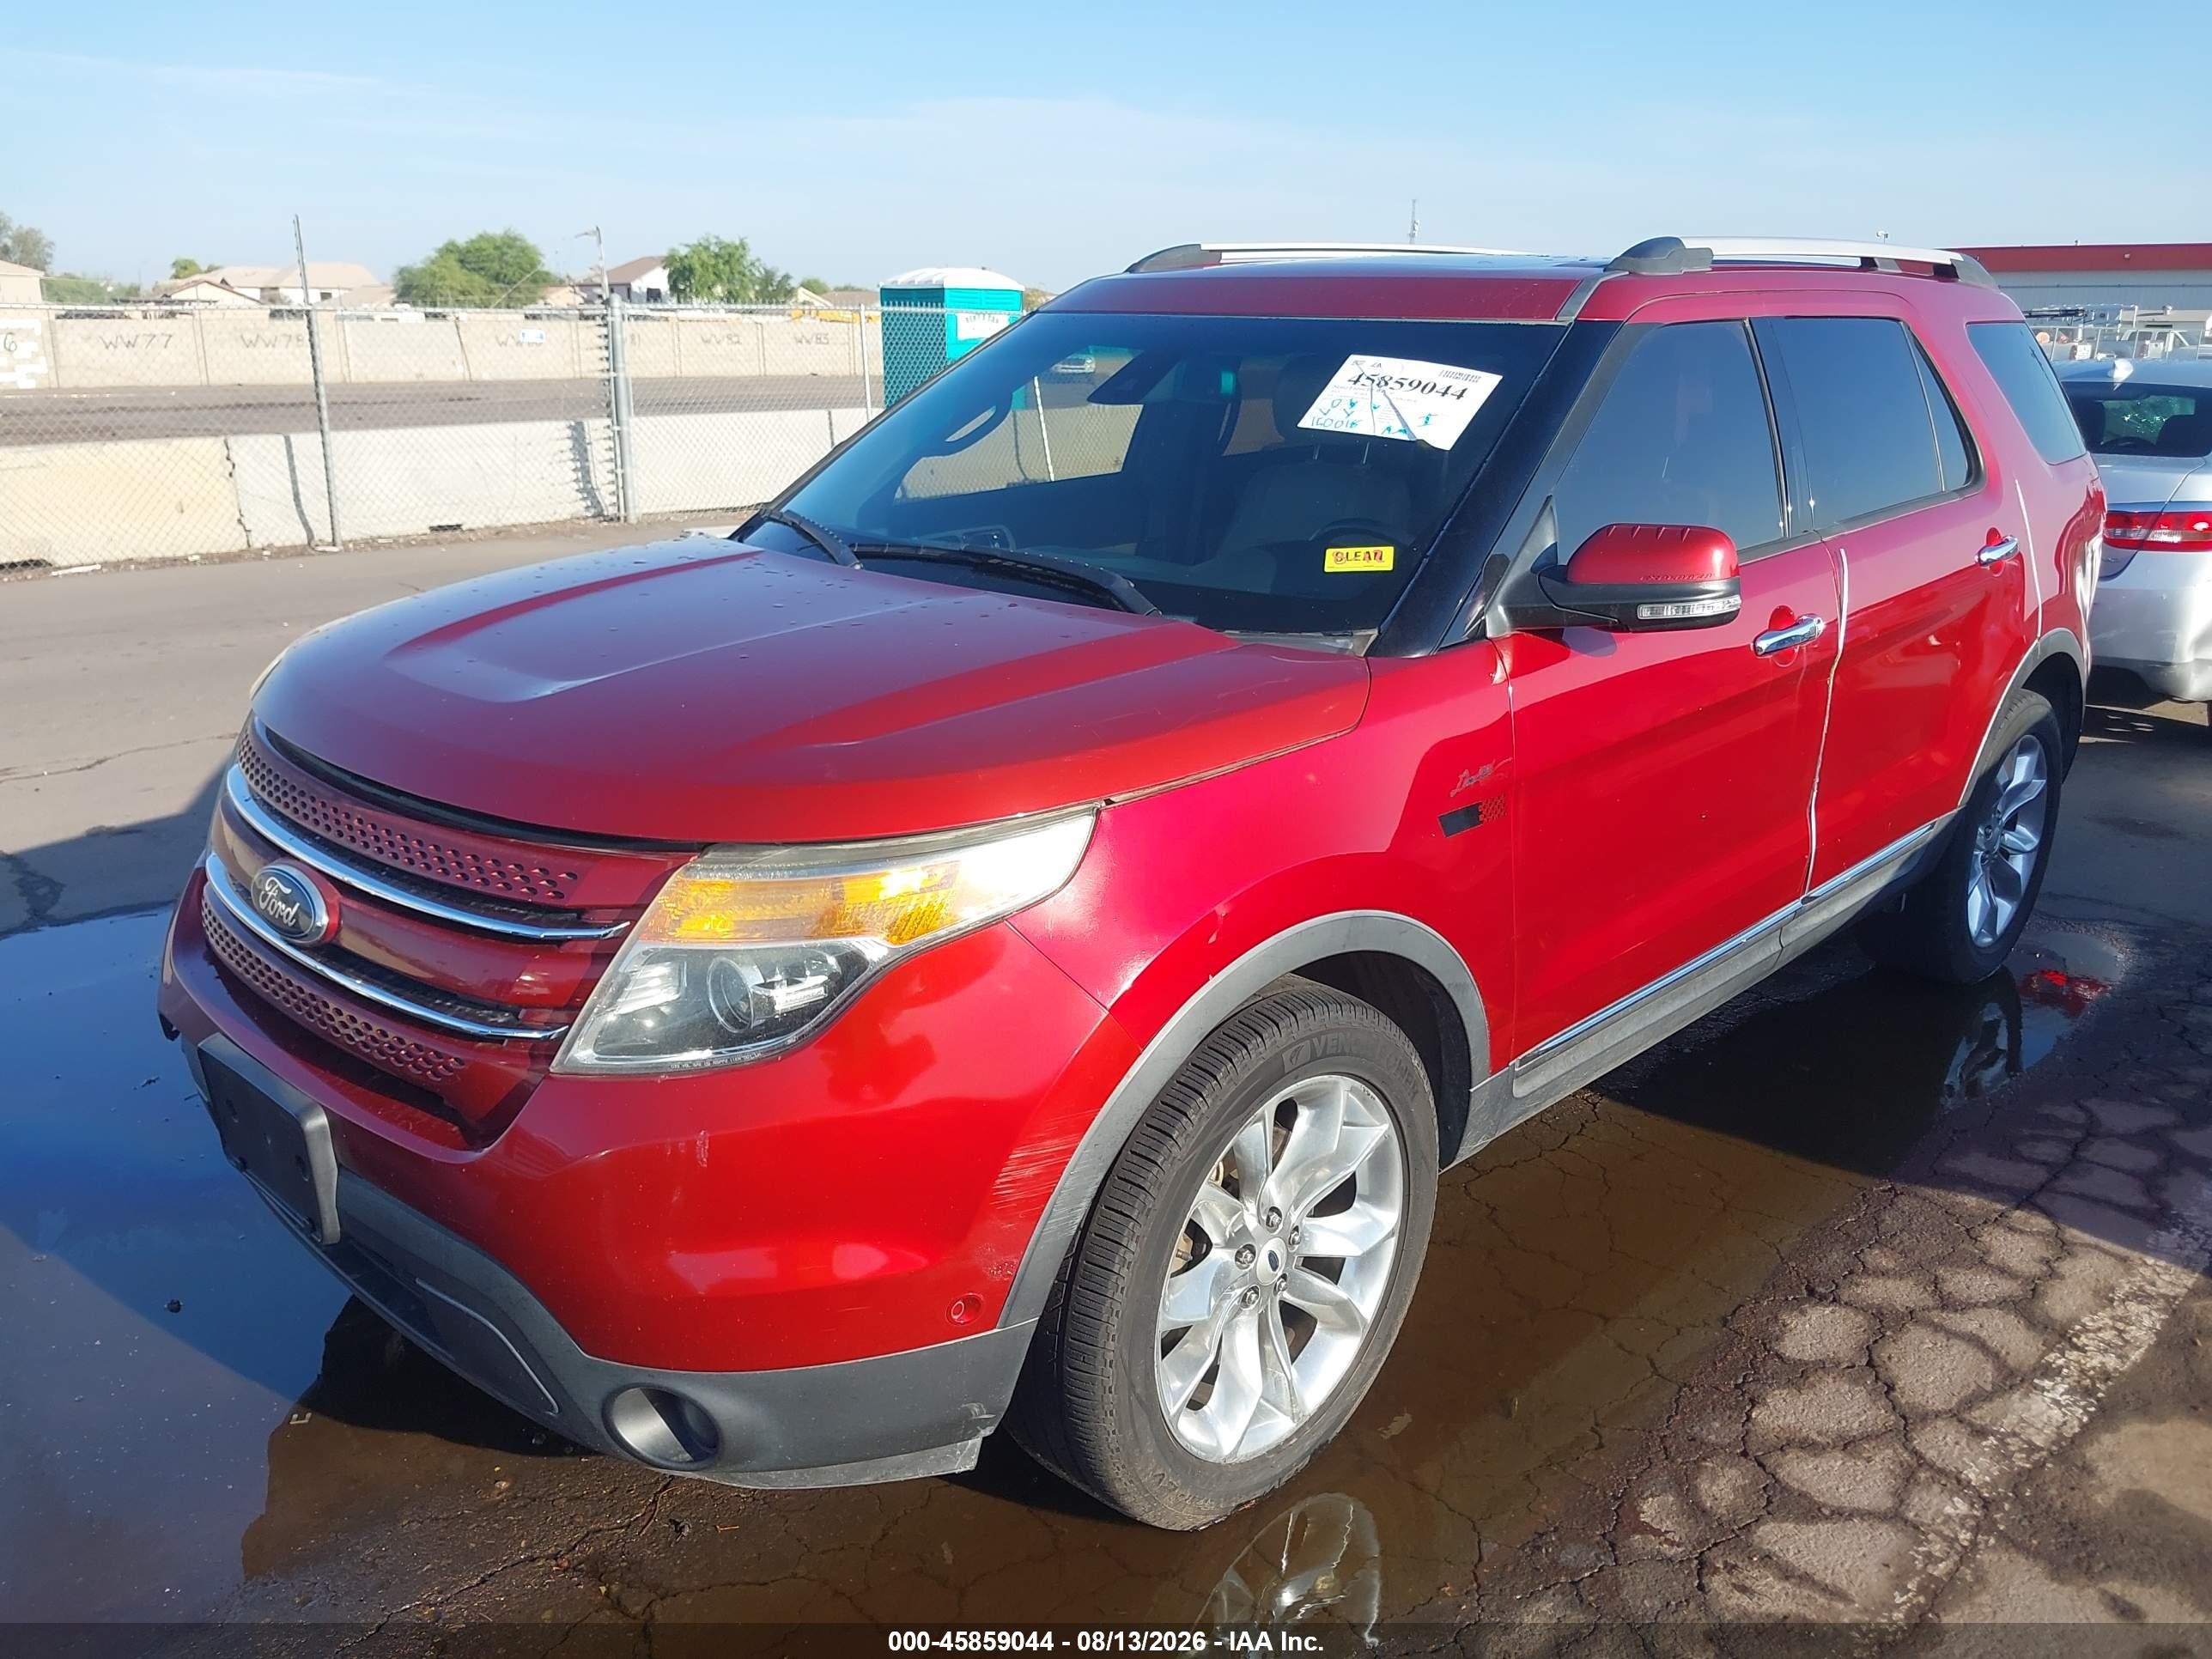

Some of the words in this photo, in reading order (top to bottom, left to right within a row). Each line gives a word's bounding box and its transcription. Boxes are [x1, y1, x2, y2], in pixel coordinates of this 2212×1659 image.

[100, 334, 173, 349] WW77
[1347, 372, 1468, 401] 45859044
[259, 877, 301, 927] Ford
